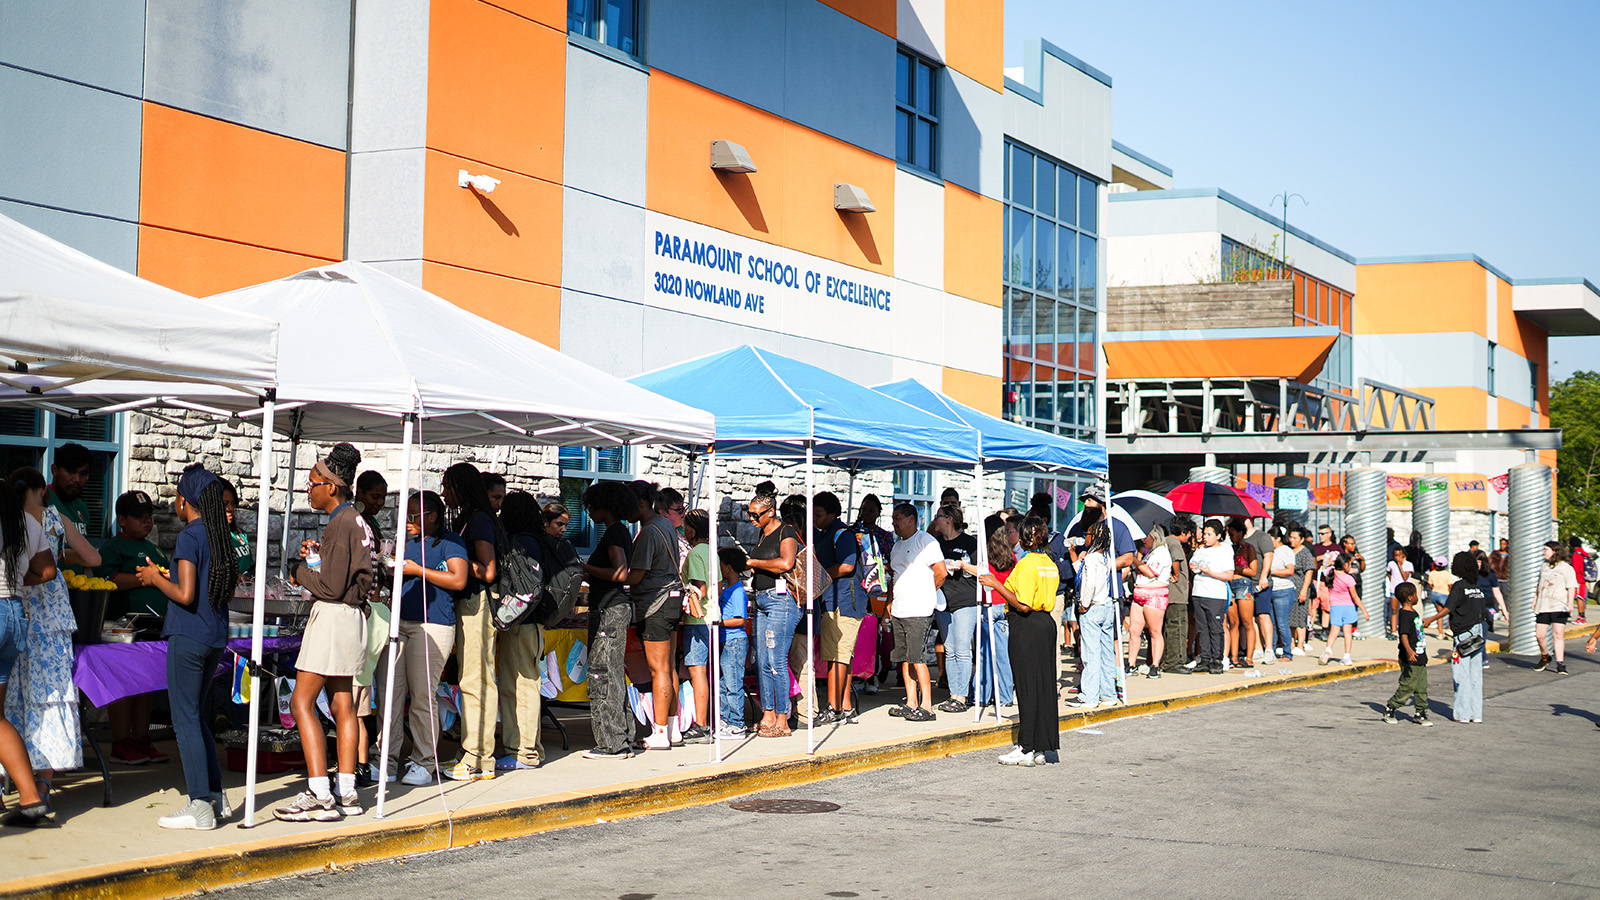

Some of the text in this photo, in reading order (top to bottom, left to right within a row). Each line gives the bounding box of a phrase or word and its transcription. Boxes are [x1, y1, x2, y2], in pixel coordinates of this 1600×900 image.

[653, 271, 765, 314] 3020 NOWLAND AVE
[654, 230, 892, 312] PARAMOUNT SCHOOL OF EXCELLENCE
